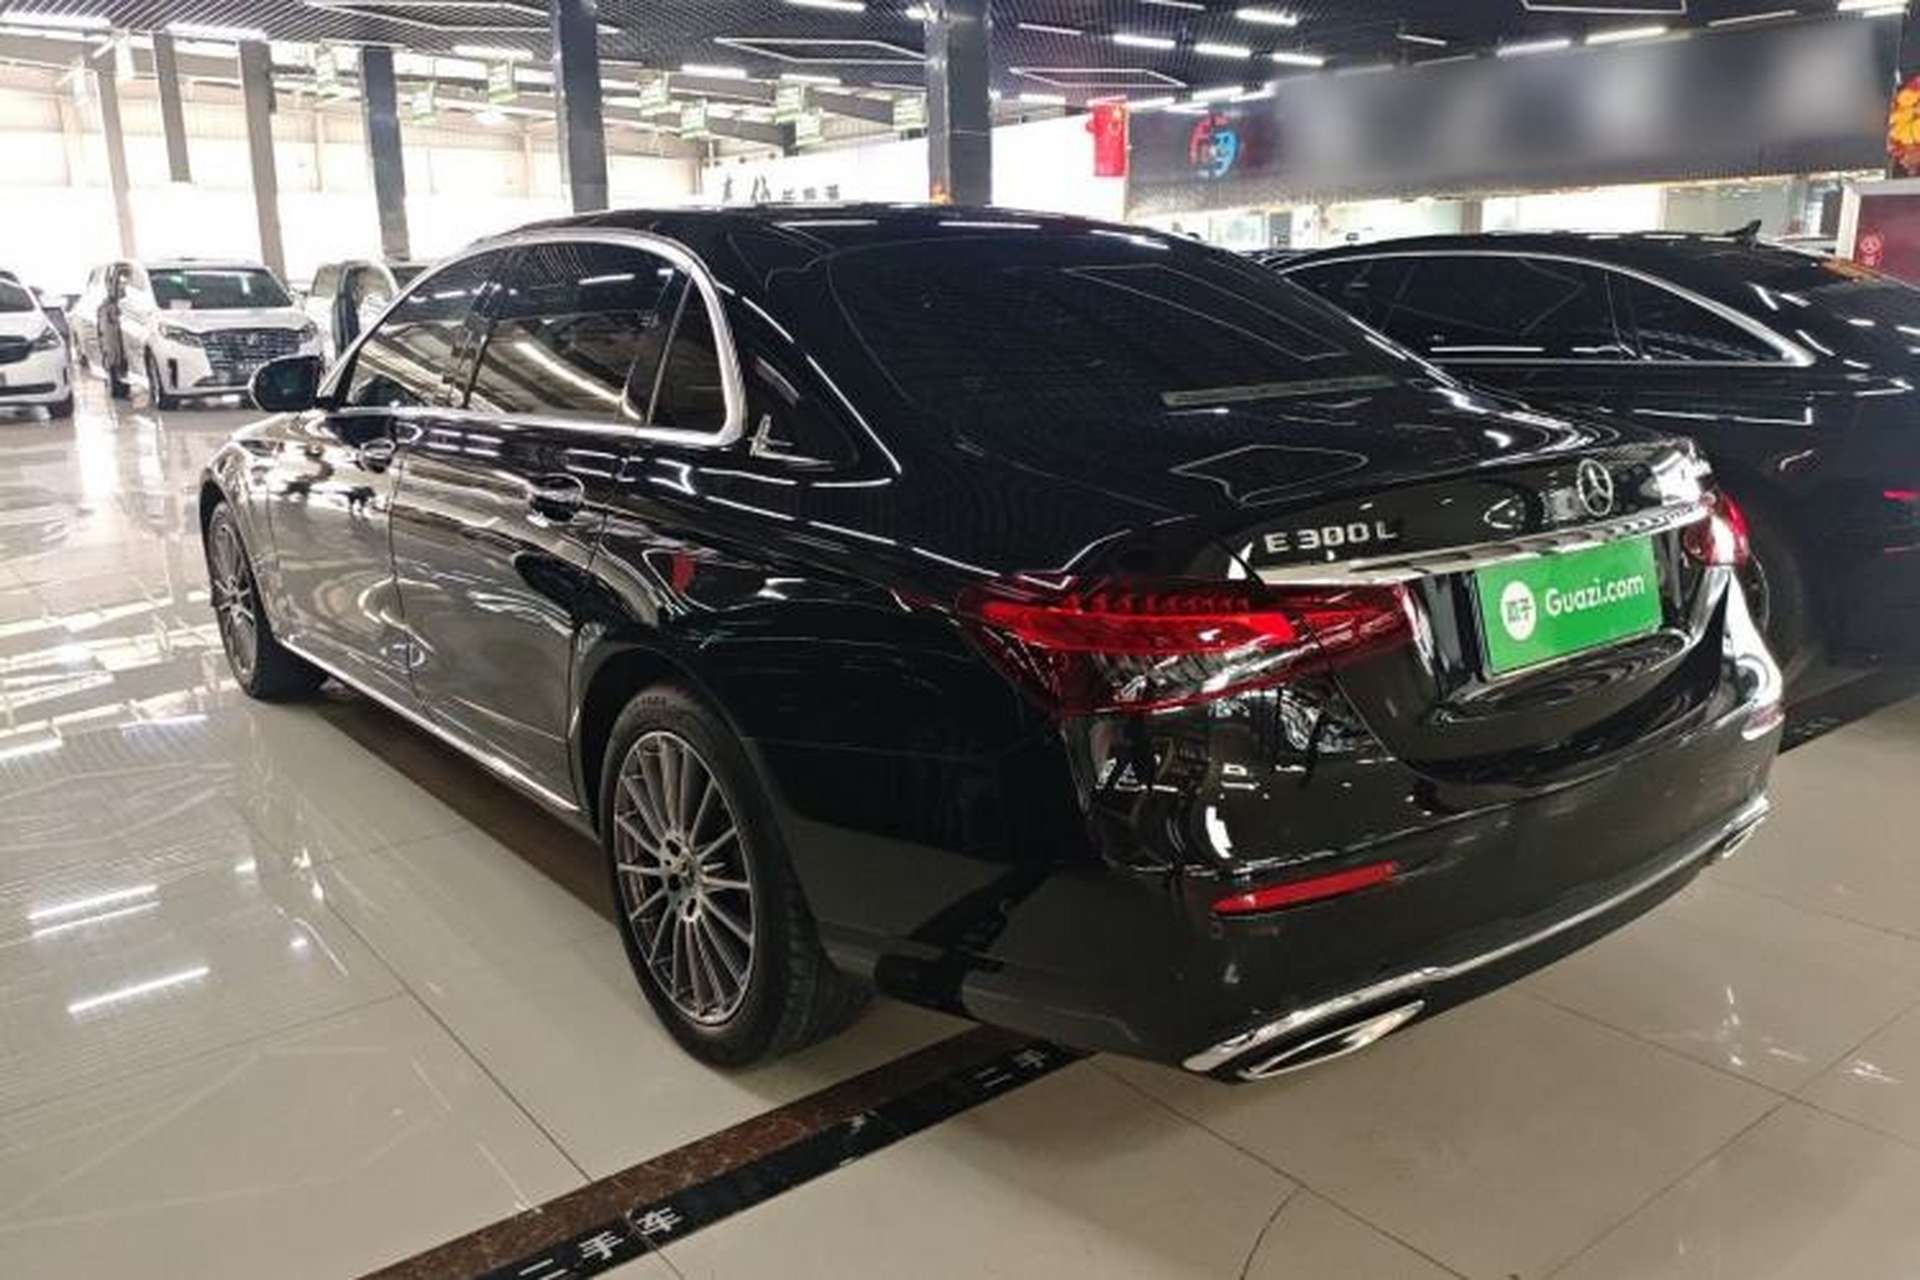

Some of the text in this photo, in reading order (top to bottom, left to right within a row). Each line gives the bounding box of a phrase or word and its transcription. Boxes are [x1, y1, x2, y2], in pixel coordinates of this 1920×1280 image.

[1264, 521, 1398, 553] E 300 L
